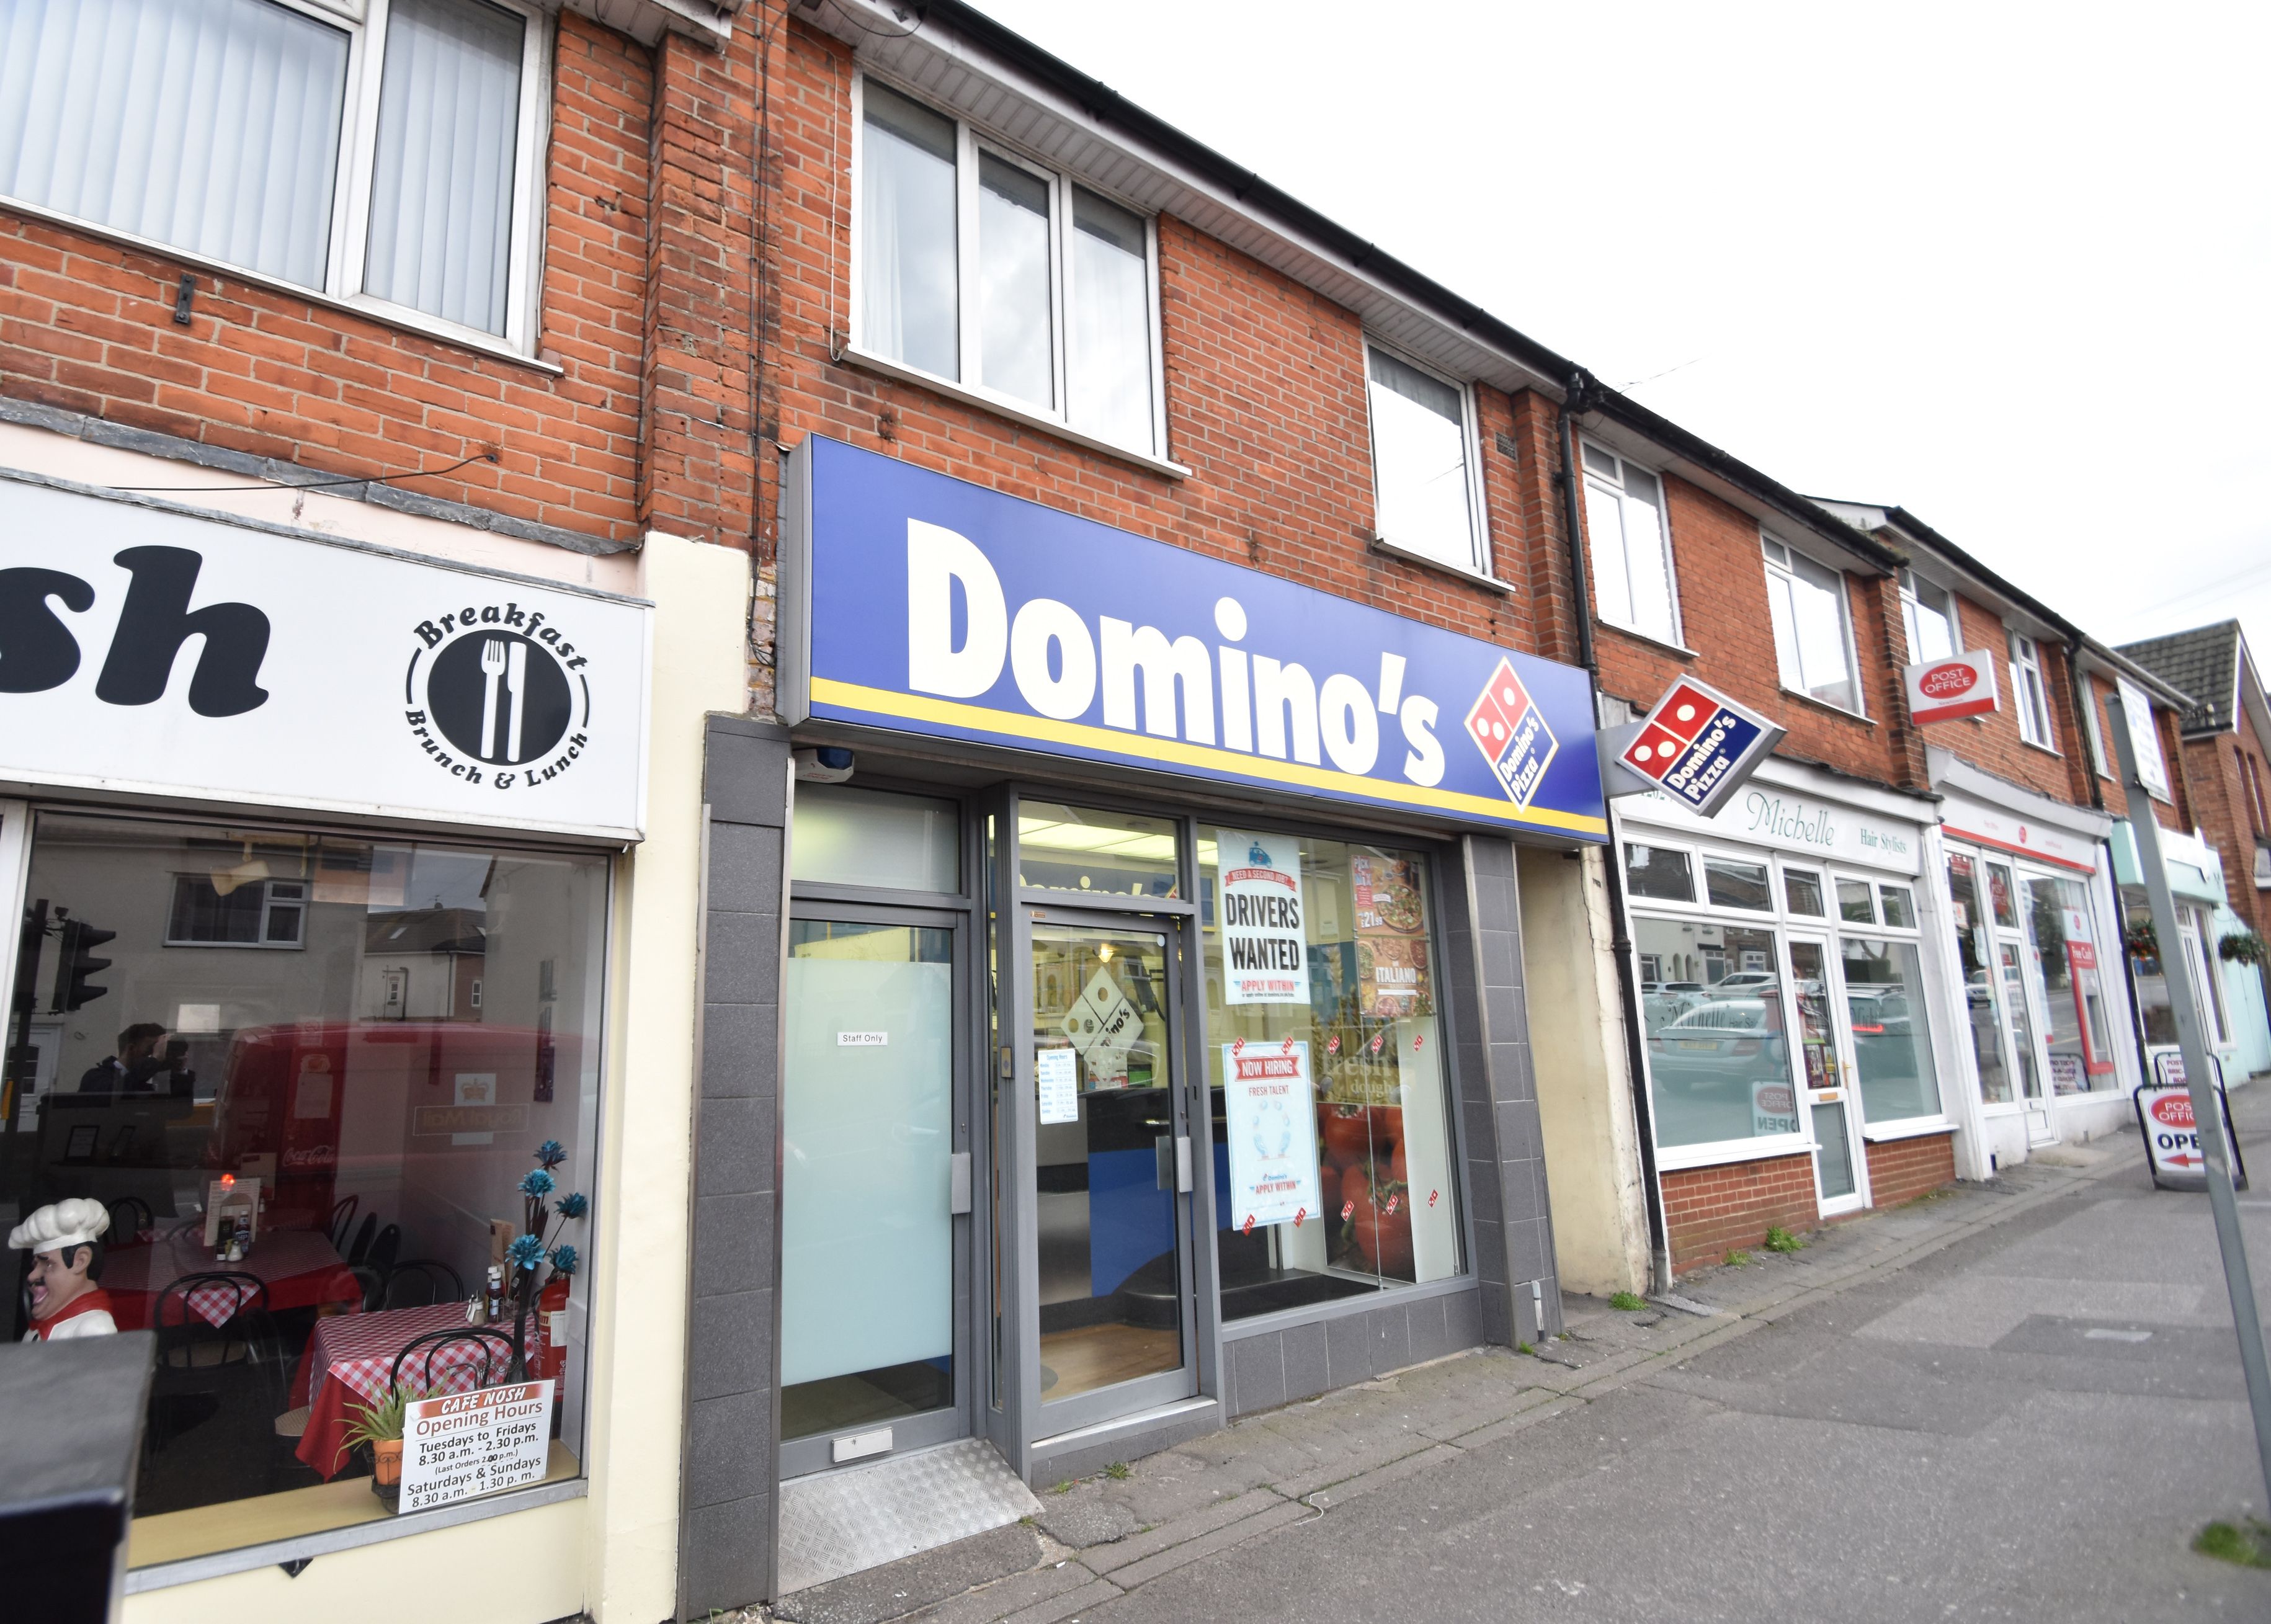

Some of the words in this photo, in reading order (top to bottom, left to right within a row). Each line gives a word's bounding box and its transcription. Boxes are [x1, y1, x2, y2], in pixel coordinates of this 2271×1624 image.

[414, 602, 588, 671] Breakfast
[907, 517, 1445, 787] Domino's
[1925, 677, 1971, 694] OFFICE
[1931, 668, 1965, 682] POST
[406, 709, 483, 784] Brunch
[494, 772, 515, 790] &
[524, 733, 588, 787] Lunch
[1499, 716, 1540, 782] Domino's
[1666, 715, 1736, 789] Domino's
[1510, 756, 1539, 800] Pizza
[1684, 755, 1731, 801] Pizza
[1746, 792, 1835, 847] Michelle
[1860, 828, 1878, 848] Hair
[1880, 834, 1907, 855] Stylists
[1232, 870, 1246, 880] NEED
[1247, 870, 1252, 878] A
[1252, 870, 1274, 880] SECOND
[1225, 893, 1300, 930] DRIVERS
[1229, 937, 1300, 971] WANTED
[1242, 980, 1265, 991] APPLY
[1267, 980, 1295, 991] WITHIN
[1376, 967, 1417, 983] ITALIANO
[842, 1034, 862, 1043] Staff
[864, 1034, 883, 1044] Only
[1242, 1061, 1262, 1077] NOW
[1264, 1058, 1293, 1076] HIRING
[1248, 1086, 1268, 1097] FRESH
[1269, 1084, 1289, 1096] TALENT
[2159, 1112, 2195, 1122] OFFIC
[2164, 1102, 2193, 1112] POS
[2157, 1133, 2201, 1150] OPE
[1256, 1183, 1274, 1195] APPLY
[1275, 1180, 1296, 1192] WITHIN
[441, 1394, 477, 1414] CAFE
[483, 1386, 527, 1406] NOSH
[416, 1411, 489, 1437] Opening
[494, 1401, 543, 1421] Hours
[419, 1434, 474, 1454] Tuesdays
[477, 1431, 489, 1446] to
[496, 1422, 537, 1438] Fridays
[419, 1450, 445, 1466] 8.30
[448, 1447, 475, 1461] a.m.
[486, 1437, 511, 1452] 2.30
[514, 1433, 539, 1448] p.m.
[435, 1464, 453, 1475] (Last
[456, 1459, 480, 1471] Orders
[481, 1453, 498, 1463] 2.00
[499, 1448, 519, 1461] p.m.)
[407, 1472, 472, 1496] Saturdays
[476, 1467, 486, 1480] &
[490, 1457, 542, 1476] Sundays
[412, 1492, 439, 1508] 8.30
[442, 1488, 468, 1501] a.m.
[479, 1478, 504, 1492] 1.30
